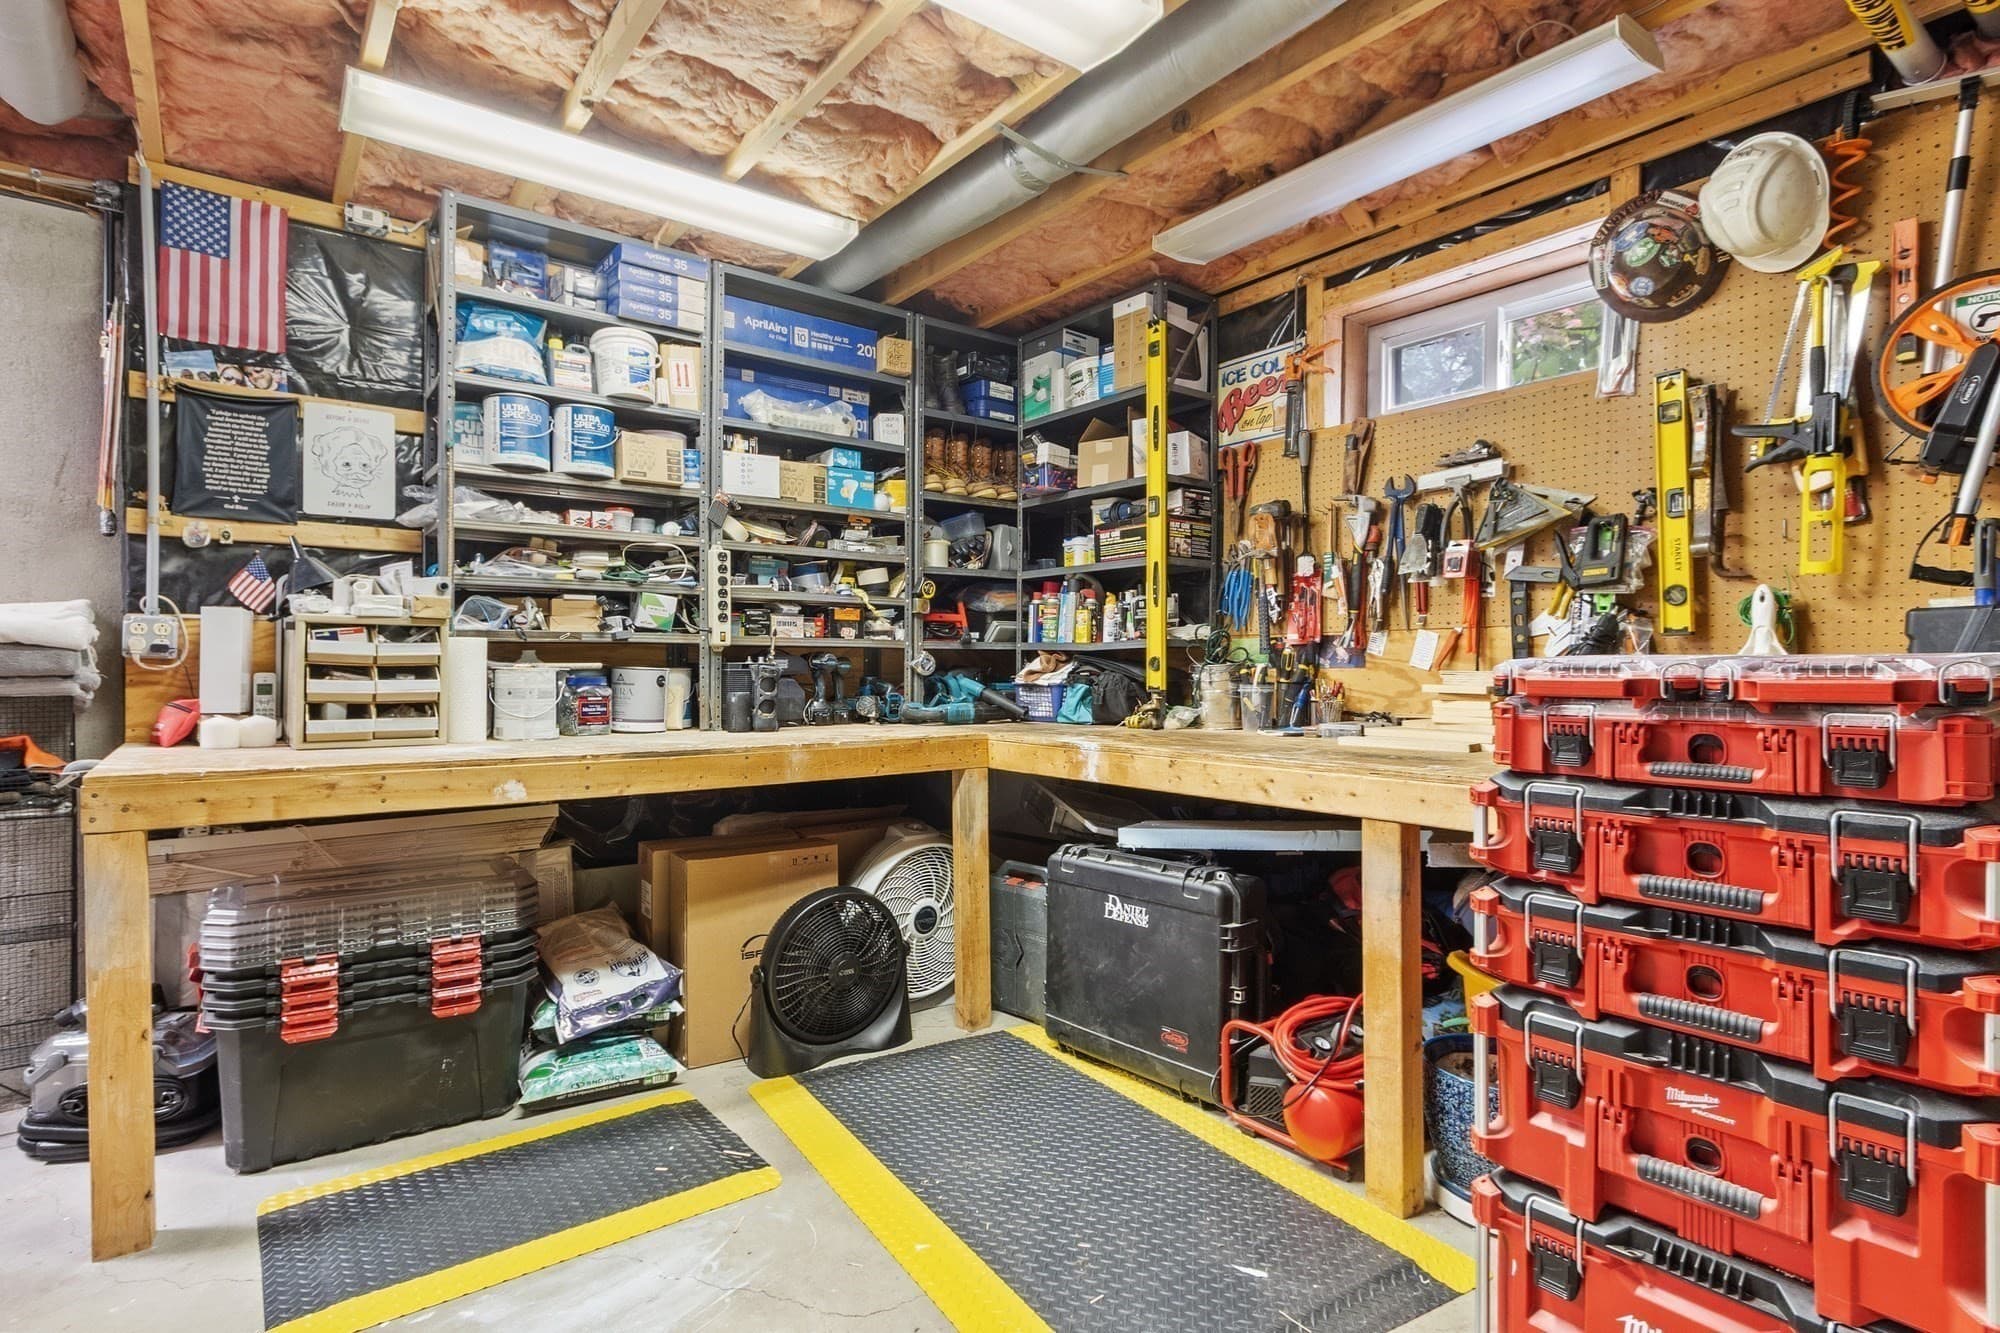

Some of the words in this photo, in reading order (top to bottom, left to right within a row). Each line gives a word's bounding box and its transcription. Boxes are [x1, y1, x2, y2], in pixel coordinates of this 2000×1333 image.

[673, 259, 688, 271] 35
[658, 274, 672, 286] 35
[658, 290, 672, 303] 35
[658, 309, 672, 320] 35
[744, 316, 788, 334] AprilAire
[1222, 366, 1247, 388] ICE
[1250, 356, 1284, 379] COL
[502, 403, 530, 412] ULTRA
[1218, 374, 1288, 436] Beer
[502, 410, 525, 419] SPEC
[527, 414, 542, 423] 500
[574, 413, 600, 422] ULTRA
[1242, 418, 1254, 429] on
[1254, 406, 1272, 432] Tap
[574, 420, 596, 430] SPEC
[597, 424, 610, 433] 500
[856, 419, 867, 433] 01
[1108, 894, 1146, 918] DANIEL
[1104, 902, 1150, 928] DEFENSE
[1664, 1086, 1720, 1104] Milwaukee
